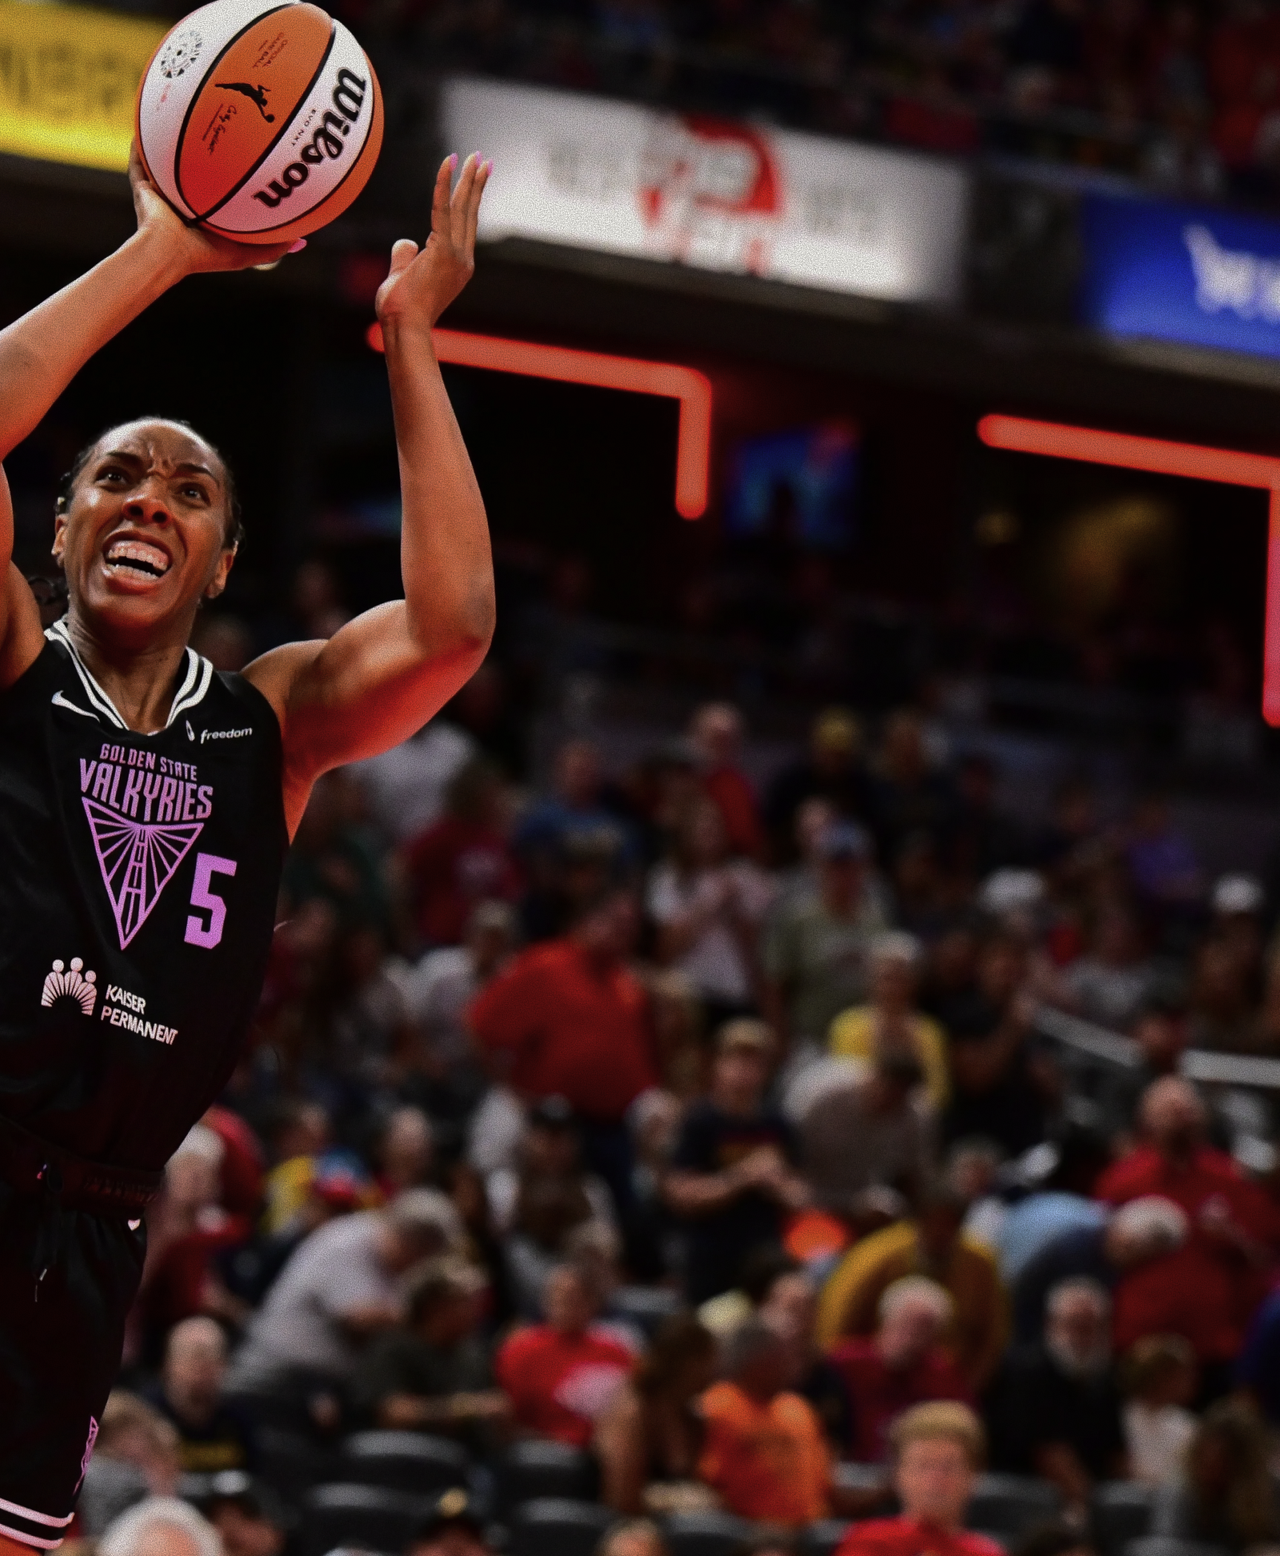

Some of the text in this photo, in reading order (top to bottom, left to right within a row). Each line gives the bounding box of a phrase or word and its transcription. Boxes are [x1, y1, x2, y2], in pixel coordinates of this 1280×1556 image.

[253, 66, 366, 208] Wilson
[291, 109, 317, 147] EVO NXT
[200, 727, 253, 744] freedom
[99, 743, 198, 782] GOLDEN STATE
[79, 757, 214, 822] VALKYRIES
[184, 852, 238, 950] 5
[105, 983, 147, 1015] KAISER
[100, 1005, 179, 1045] PERMANENT
